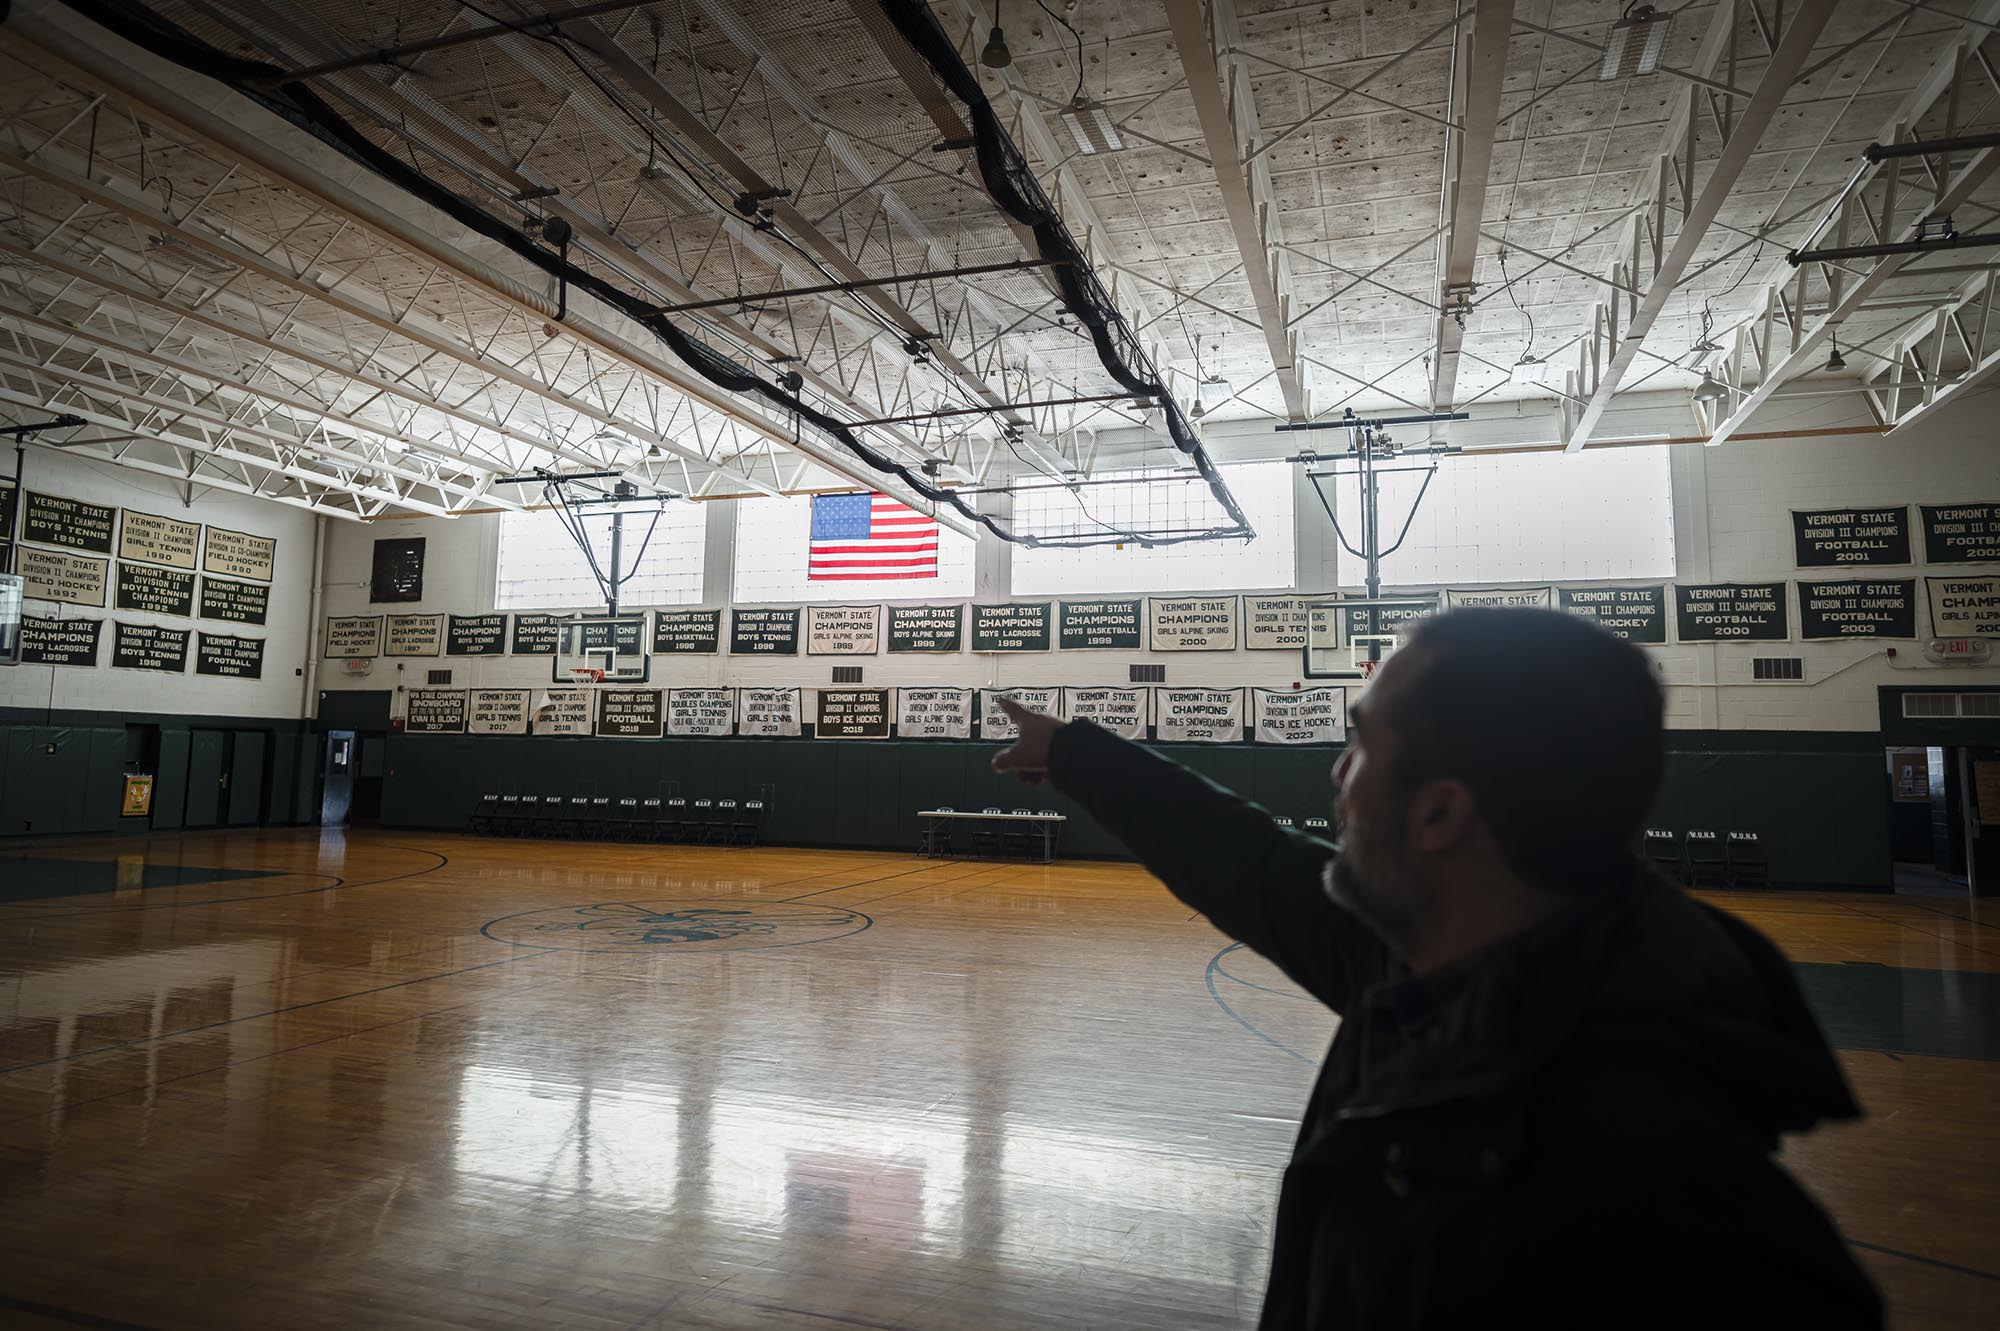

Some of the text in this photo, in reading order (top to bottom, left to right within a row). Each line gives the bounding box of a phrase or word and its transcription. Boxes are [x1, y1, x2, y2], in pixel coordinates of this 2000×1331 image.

[34, 497, 109, 518] VERMONT STATE
[30, 509, 110, 530] DIVISION II CHAMPIONS
[1806, 512, 1895, 525] VERMONT STATE
[1936, 509, 1988, 520] VERMONT
[31, 520, 107, 539] BOYS TENNIS
[130, 516, 193, 536] VERMONT STATE
[1934, 523, 1984, 534] DIVISION III
[126, 527, 150, 538] DIVISION
[164, 534, 193, 545] CHAMPIONS
[1805, 526, 1898, 538] DIVISION III CHAMPIONS
[53, 534, 84, 545] 1990
[213, 532, 268, 549] VERMONT STATE
[127, 538, 191, 554] GIRLS TENNIS
[1815, 540, 1888, 550] FOOTBALL
[146, 551, 172, 560] 1990
[208, 552, 269, 568] FIELD HOCKEY
[27, 552, 98, 571] VERMONT STATE
[24, 564, 100, 582] DIVISION II CHAMPIONS
[226, 564, 252, 573] 1990
[124, 566, 190, 582] VERMONT STATE
[58, 581, 100, 591] HOCKEY
[134, 576, 168, 588] DIVISION
[122, 583, 189, 599] BOYS TENNIS
[208, 581, 263, 596] VERMONT STATE
[1813, 585, 1902, 596] VERMONT STATE
[1943, 583, 1993, 593] VERMONT
[48, 589, 77, 598] 1992
[1571, 592, 1652, 602] VERMONT STATE
[1689, 589, 1772, 599] VERMONT STATE
[132, 592, 179, 606] CHAMPIONS
[1460, 596, 1538, 606] VERMONT STATE
[1811, 599, 1904, 609] DIVISION III CHAMPIONS
[205, 600, 263, 613] BOYS TENNIS
[1068, 604, 1132, 614] VERMONT STATE
[1161, 603, 1197, 612] VERMONT
[1256, 602, 1292, 610] VERMONT
[1568, 605, 1655, 616] DIVISION III CHAMPIONS
[1686, 602, 1776, 612] DIVISION III CHAMPIONS
[895, 609, 928, 618] VERMONT
[981, 608, 1041, 617] VERMONT STATE
[1255, 613, 1288, 622] DIVISION II
[1822, 612, 1893, 621] FOOTBALL
[1942, 612, 1969, 620] GIRLS
[894, 620, 955, 628] CHAMPIONS
[978, 618, 1043, 627] CHAMPIONS
[1066, 616, 1135, 624] CHAMPIONS
[1158, 615, 1228, 623] CHAMPIONS
[1600, 619, 1649, 627] HOCKEY
[1696, 616, 1767, 624] FOOTBALL
[23, 618, 93, 631] VERMONT STATE
[1840, 625, 1875, 633] 2003
[21, 630, 94, 642] CHAMPIONS
[123, 627, 183, 641] VERMONT STATE
[1714, 627, 1750, 635] 2000
[48, 644, 89, 652] LACROSSE
[206, 637, 257, 649] VERMONT STATE
[1949, 640, 1968, 652] EXIT
[149, 651, 180, 660] TENNIS
[208, 657, 251, 667] FOOTBALL
[1169, 693, 1204, 702] VERMONT
[1266, 692, 1331, 704] VERMONT STATE
[1173, 706, 1227, 714] CHAMPIONS
[1266, 705, 1331, 716] DIVISION II CHAMPIONS
[1186, 718, 1234, 727] SNOWBOARDING
[1263, 718, 1336, 728] GIRLS ICE HOCKEY
